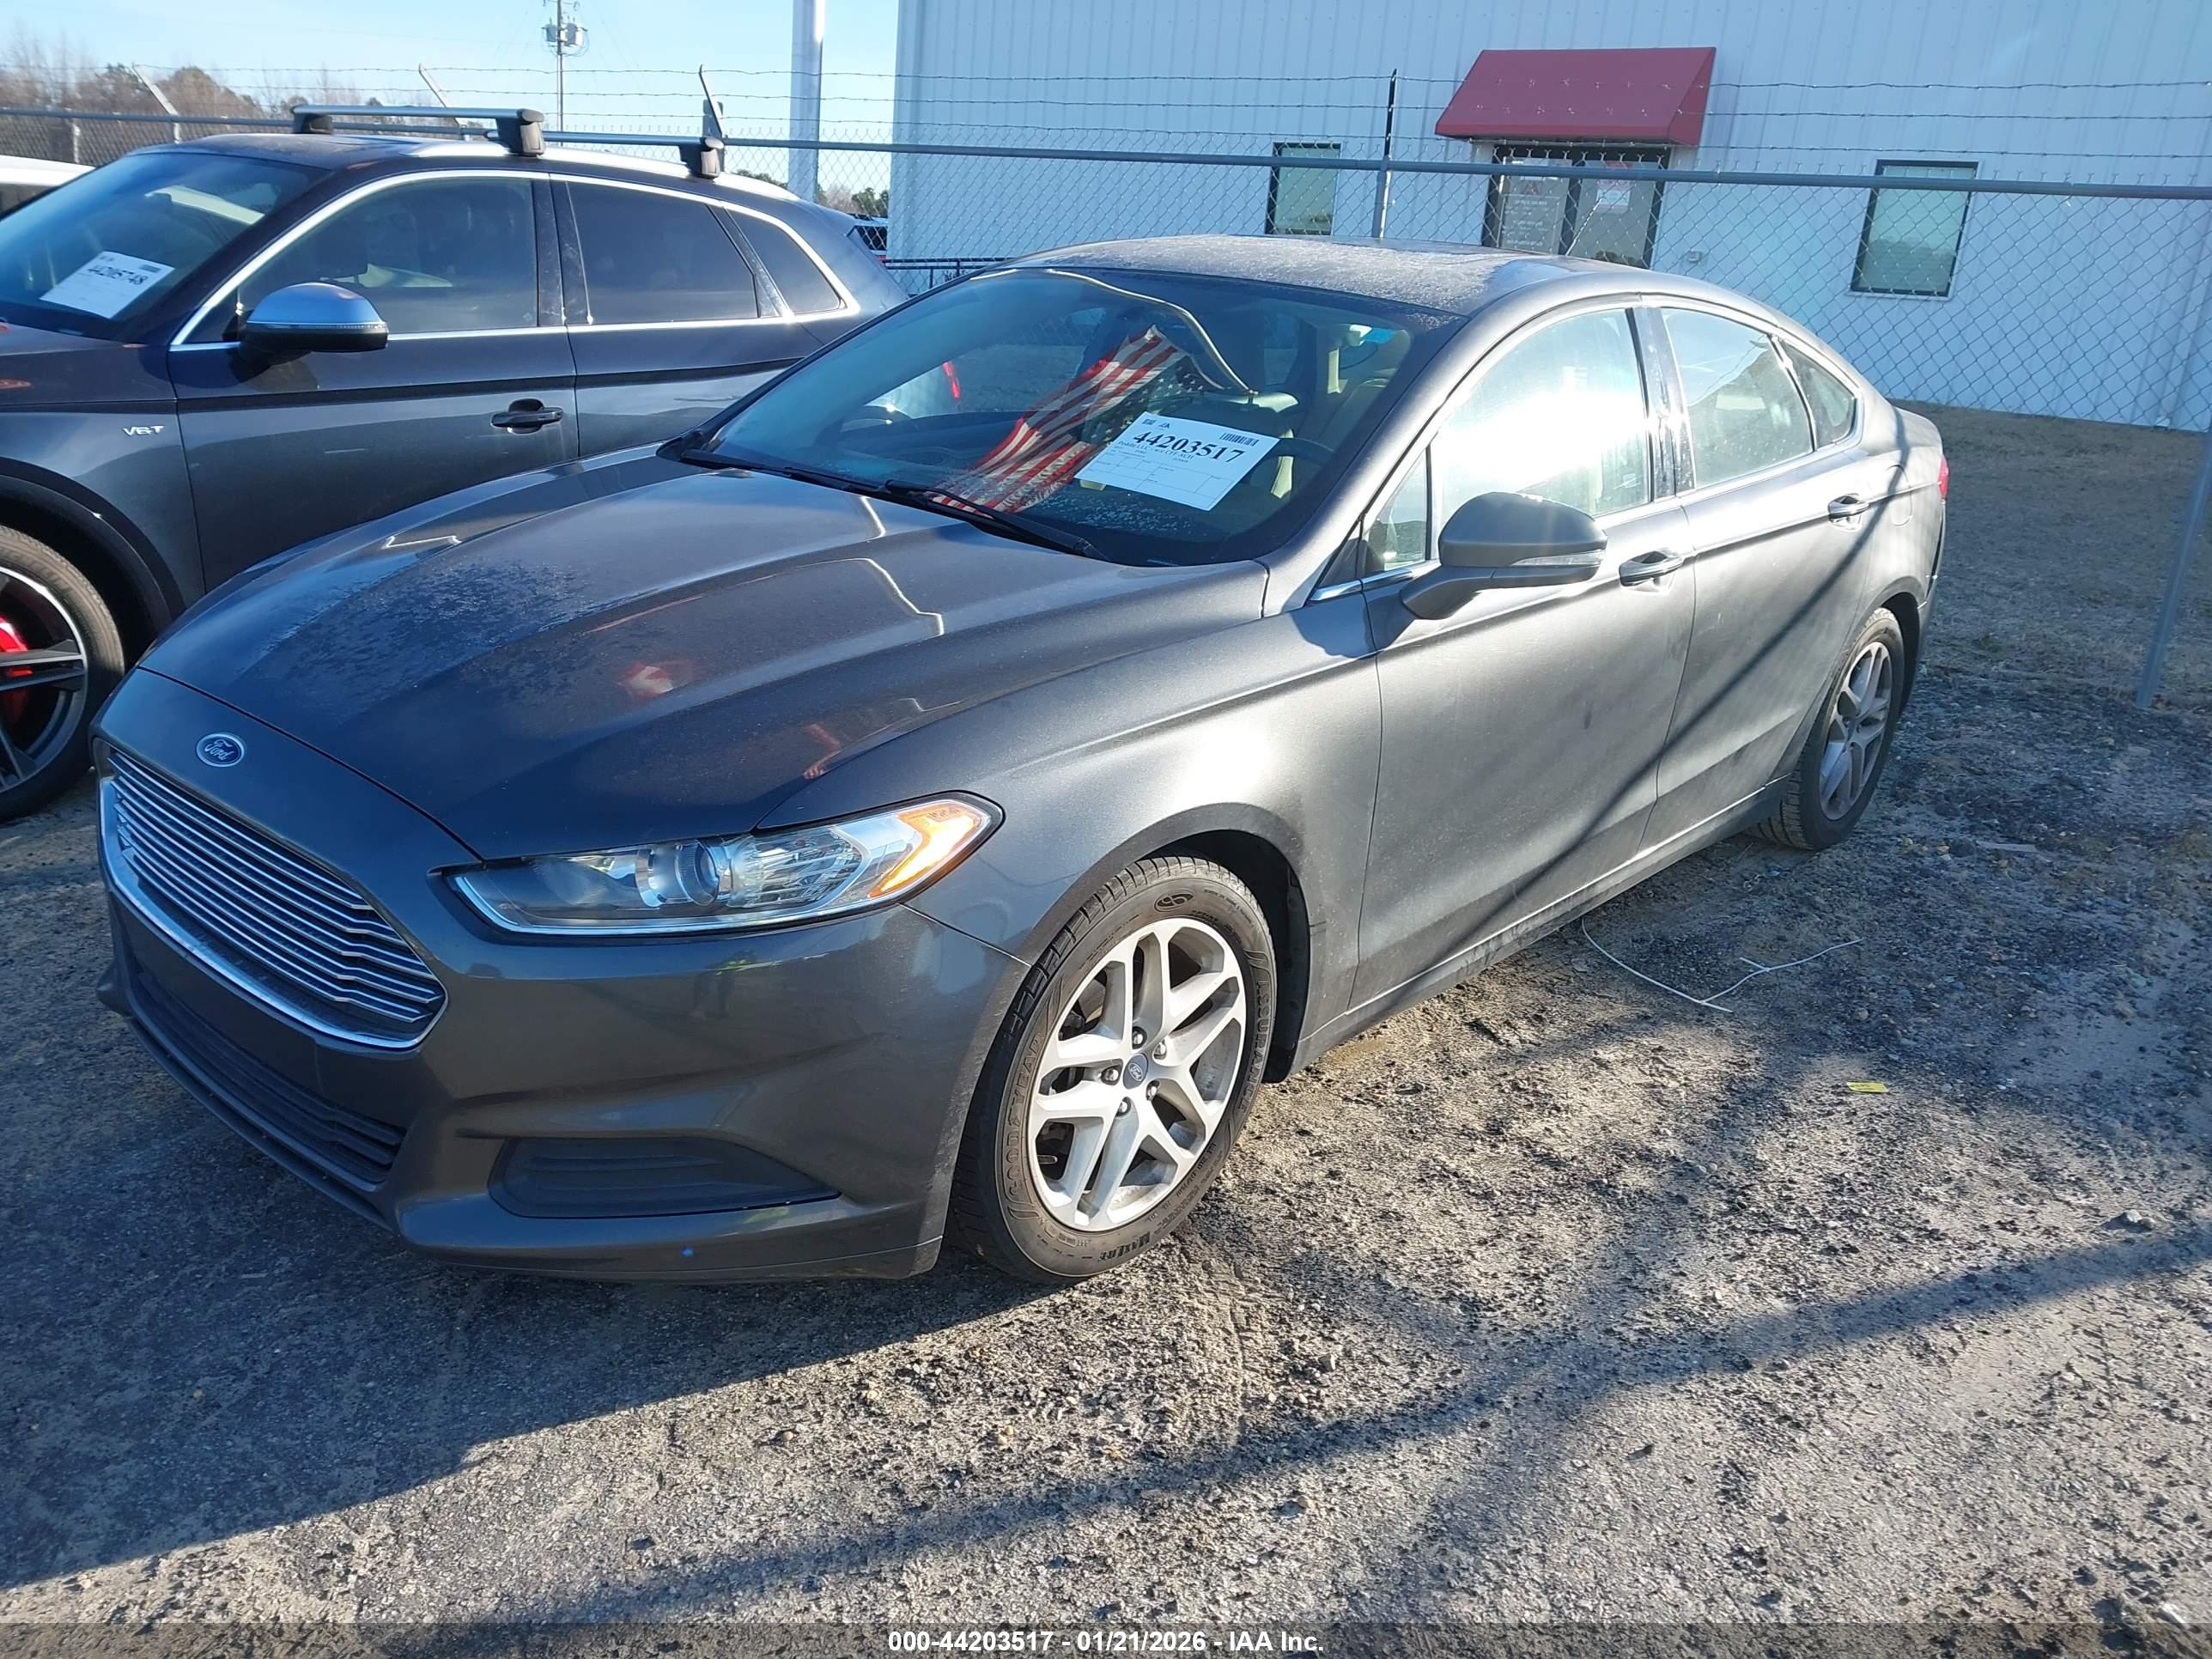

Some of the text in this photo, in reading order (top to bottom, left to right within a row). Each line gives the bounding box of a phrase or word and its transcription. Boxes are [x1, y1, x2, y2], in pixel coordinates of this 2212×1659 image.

[123, 426, 164, 436] V6T
[1133, 431, 1246, 463] 44203517
[204, 738, 234, 761] Ford
[1006, 1031, 1046, 1197] GOODYEAR
